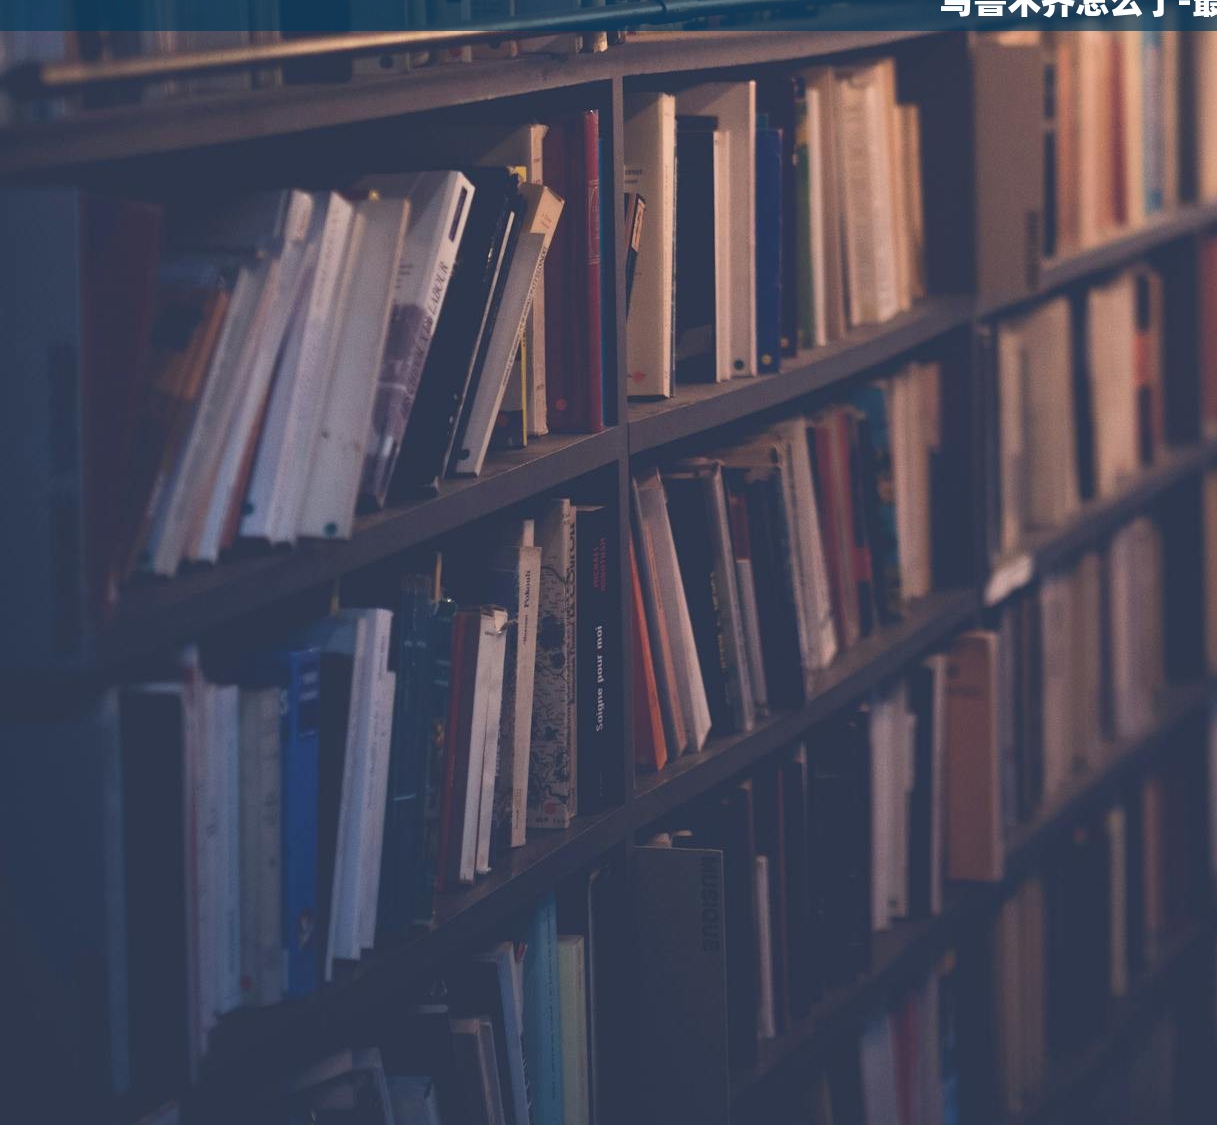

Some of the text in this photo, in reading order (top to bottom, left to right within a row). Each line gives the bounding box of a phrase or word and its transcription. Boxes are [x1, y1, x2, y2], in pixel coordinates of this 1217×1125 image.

[428, 261, 449, 315] LABOUR
[596, 654, 604, 683] pour
[595, 687, 604, 732] Saigne
